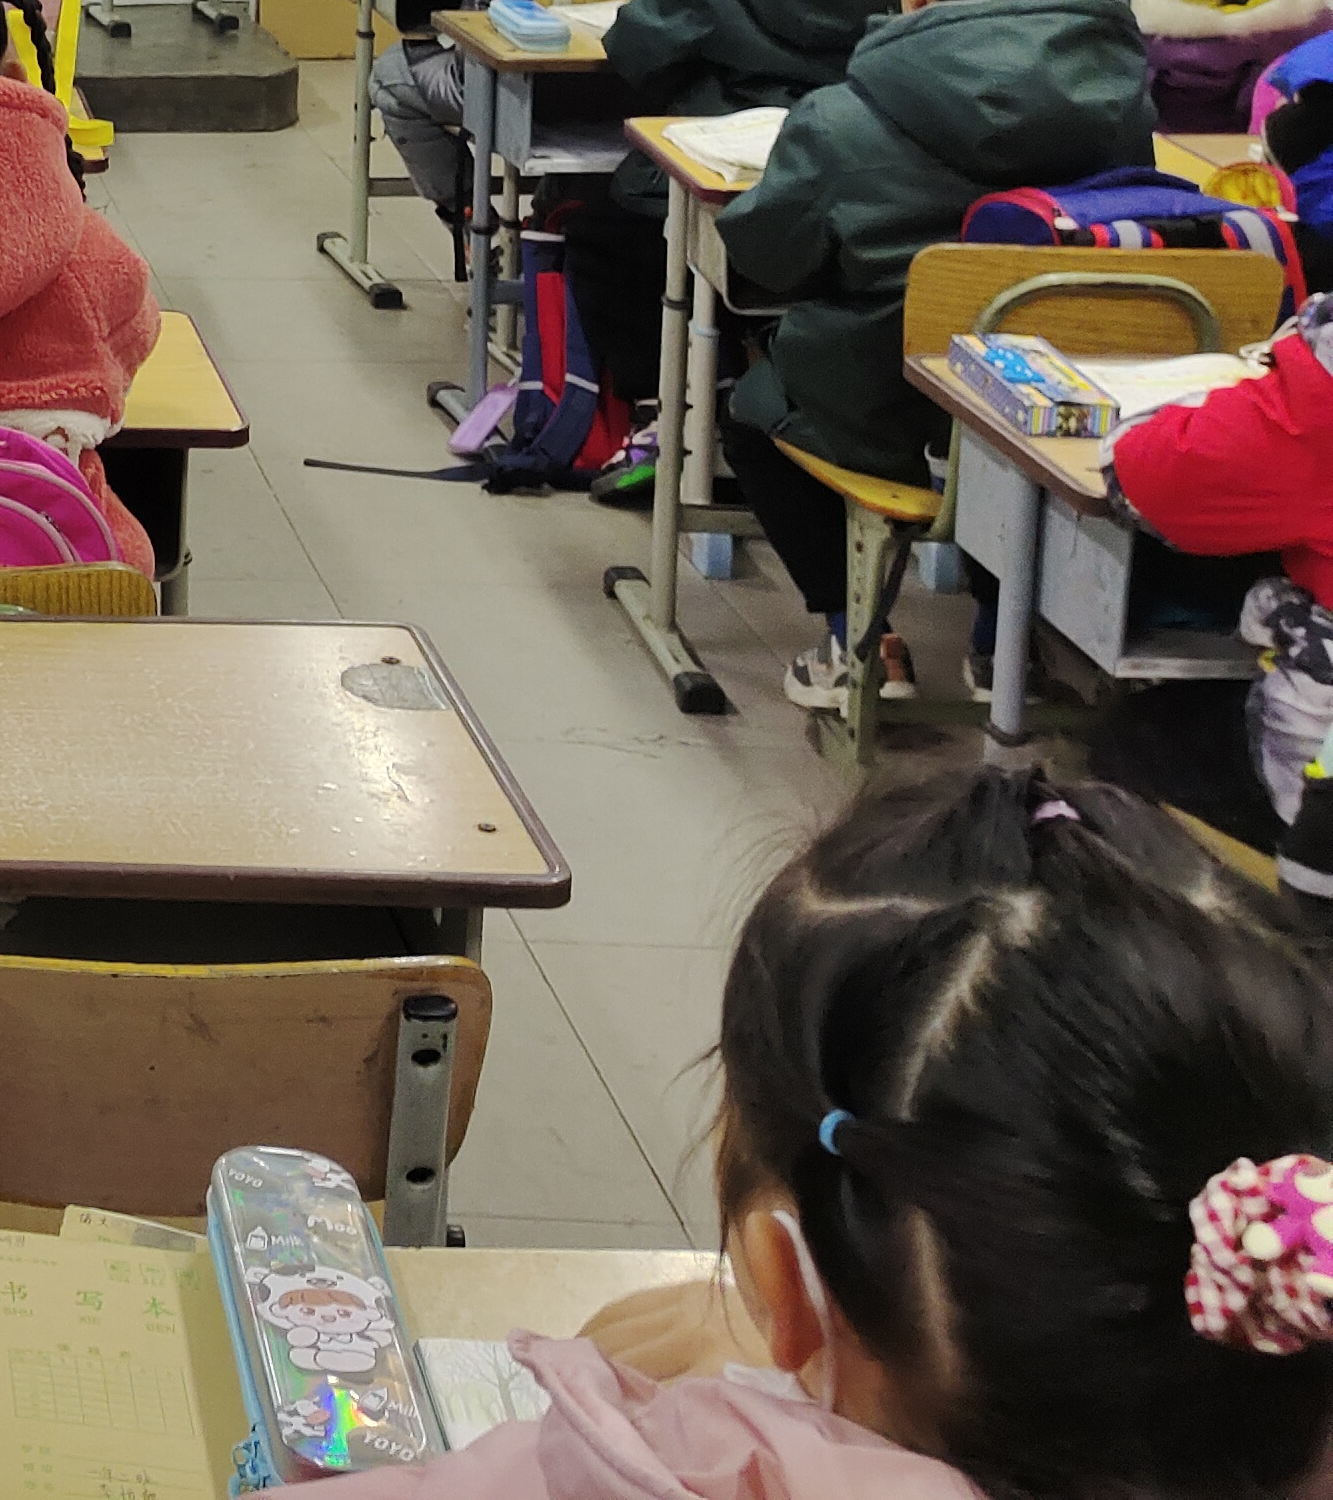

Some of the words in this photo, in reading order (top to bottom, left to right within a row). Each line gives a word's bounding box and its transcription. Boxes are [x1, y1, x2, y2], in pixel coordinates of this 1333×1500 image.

[227, 1168, 264, 1189] YOYO
[307, 1214, 359, 1236] Moo
[271, 1234, 304, 1248] Milk
[363, 1430, 415, 1462] YOYO
